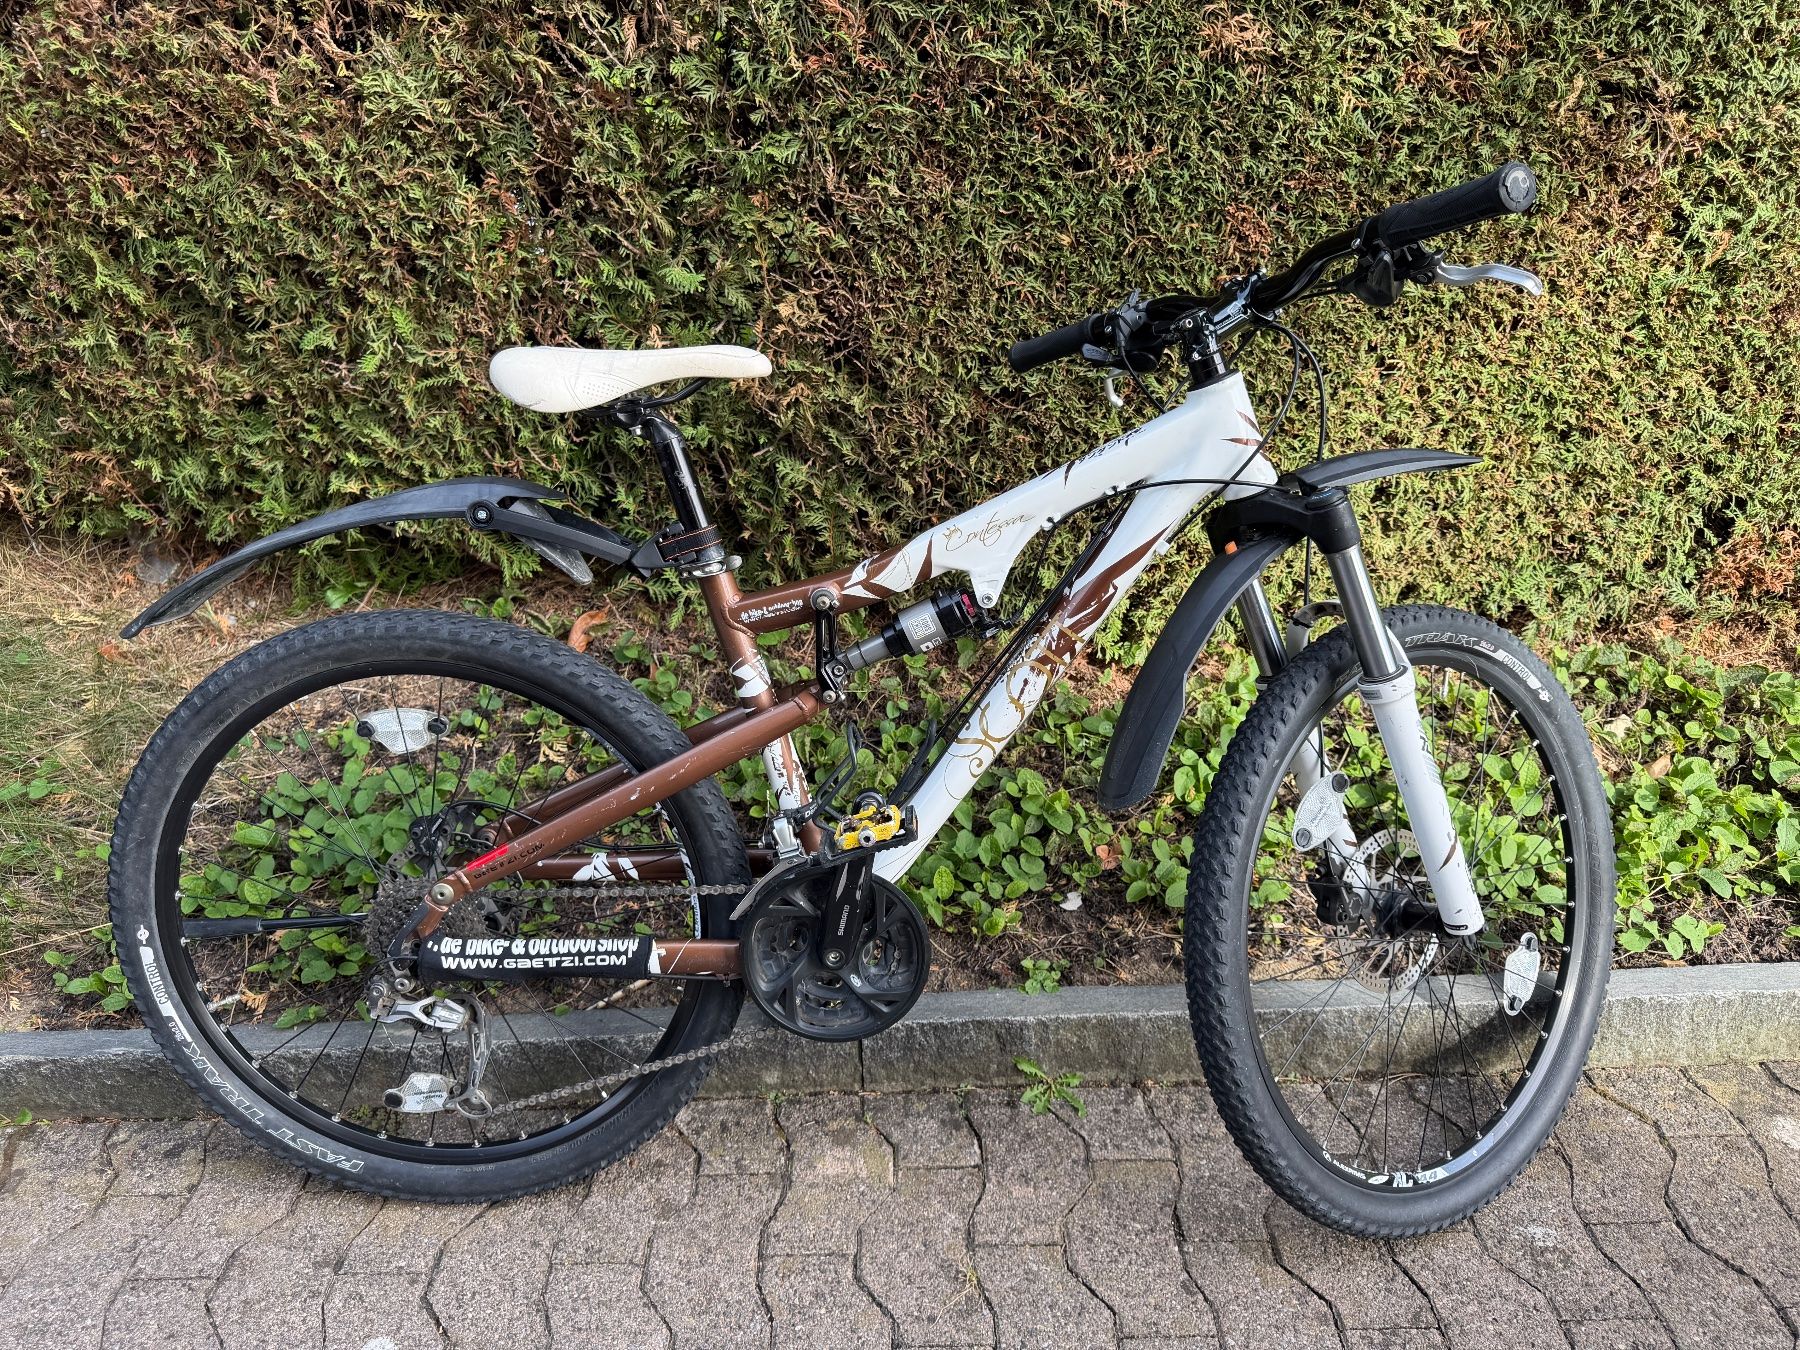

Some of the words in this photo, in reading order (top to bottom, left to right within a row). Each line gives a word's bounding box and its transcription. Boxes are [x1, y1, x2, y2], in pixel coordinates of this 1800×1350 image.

[1405, 632, 1478, 648] TRAK
[1502, 654, 1532, 682] CONTROL
[838, 904, 850, 936] SHIMANO
[144, 961, 170, 1005] CONTROL
[182, 1042, 265, 1125] TRAK
[267, 1128, 364, 1173] FAST
